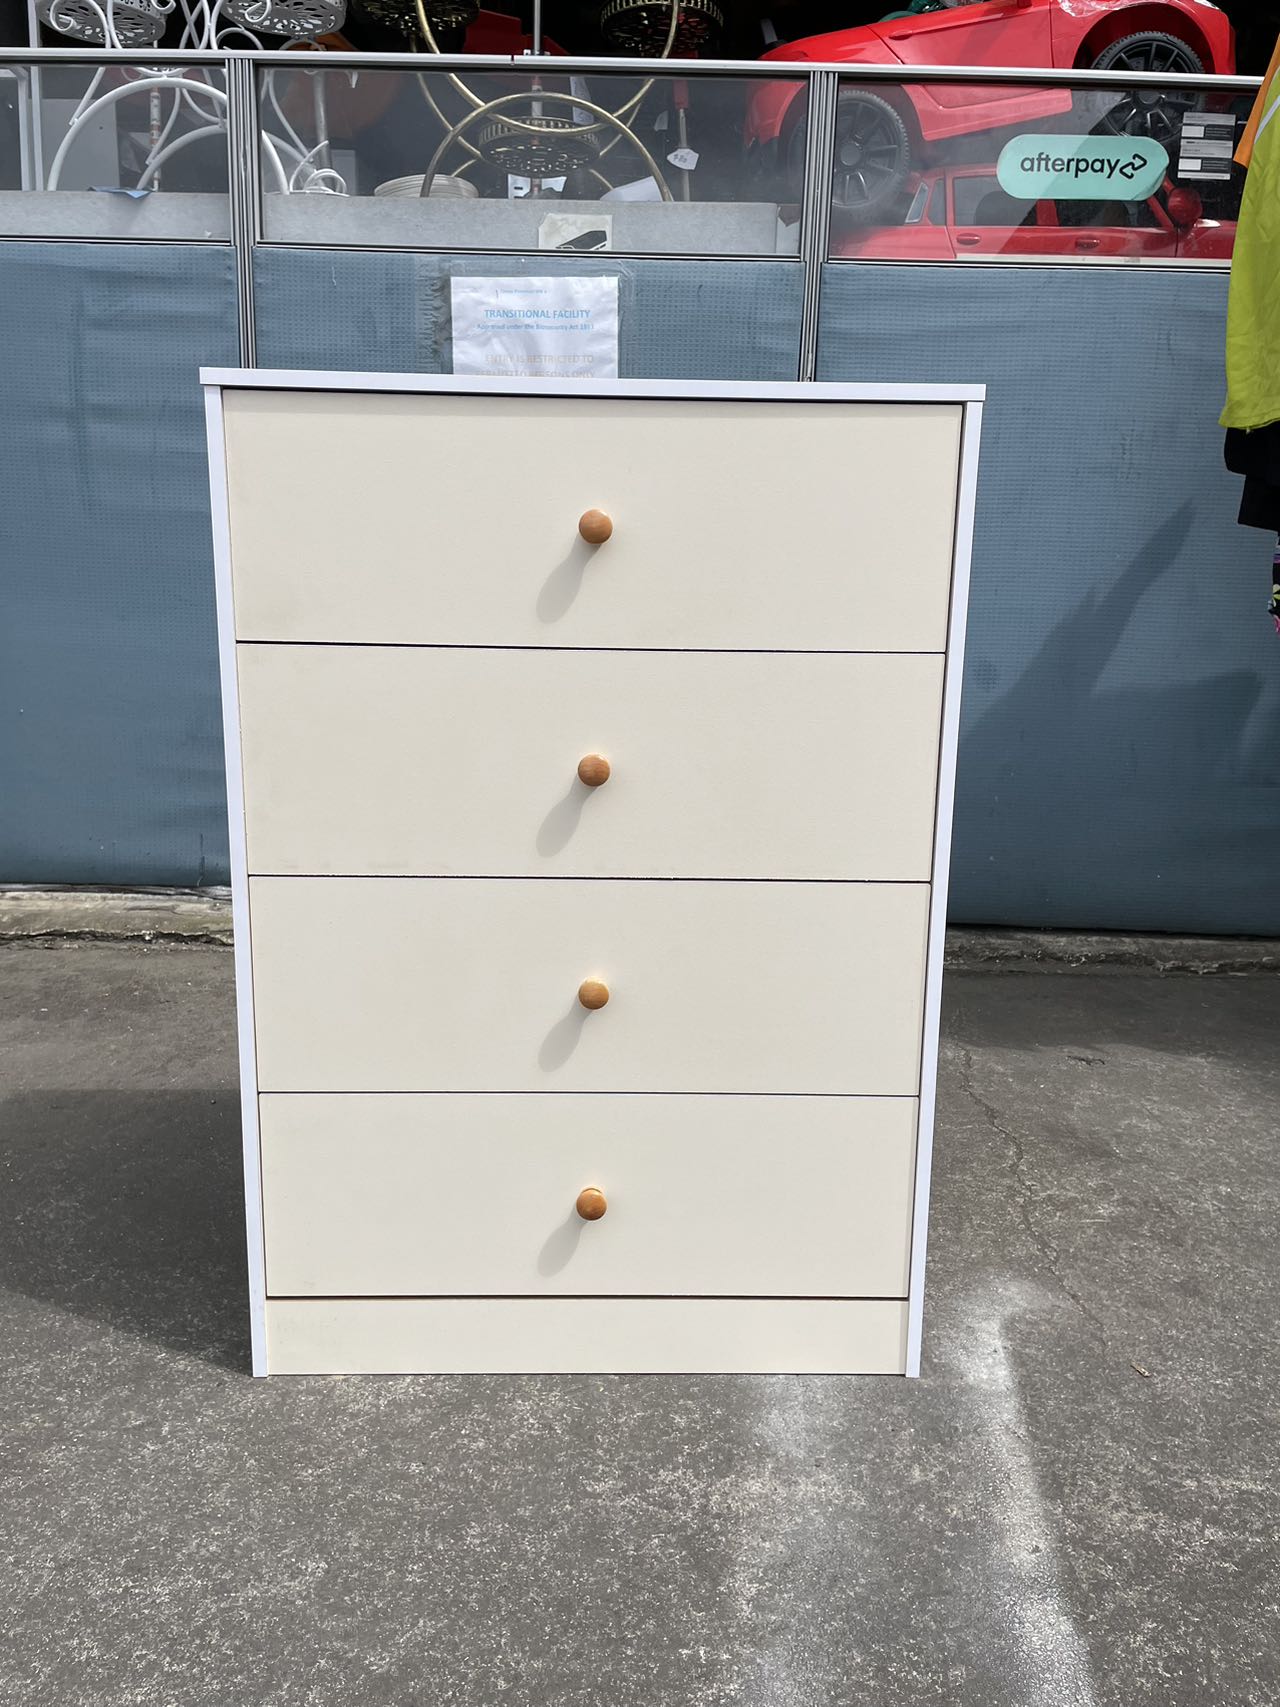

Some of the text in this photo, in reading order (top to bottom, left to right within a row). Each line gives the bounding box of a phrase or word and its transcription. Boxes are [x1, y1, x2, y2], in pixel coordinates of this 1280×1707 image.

[1020, 152, 1121, 180] afterpay
[484, 309, 591, 319] TRANSITIONAL FACILITY
[527, 354, 578, 364] RESTRICTED
[583, 354, 594, 364] TO
